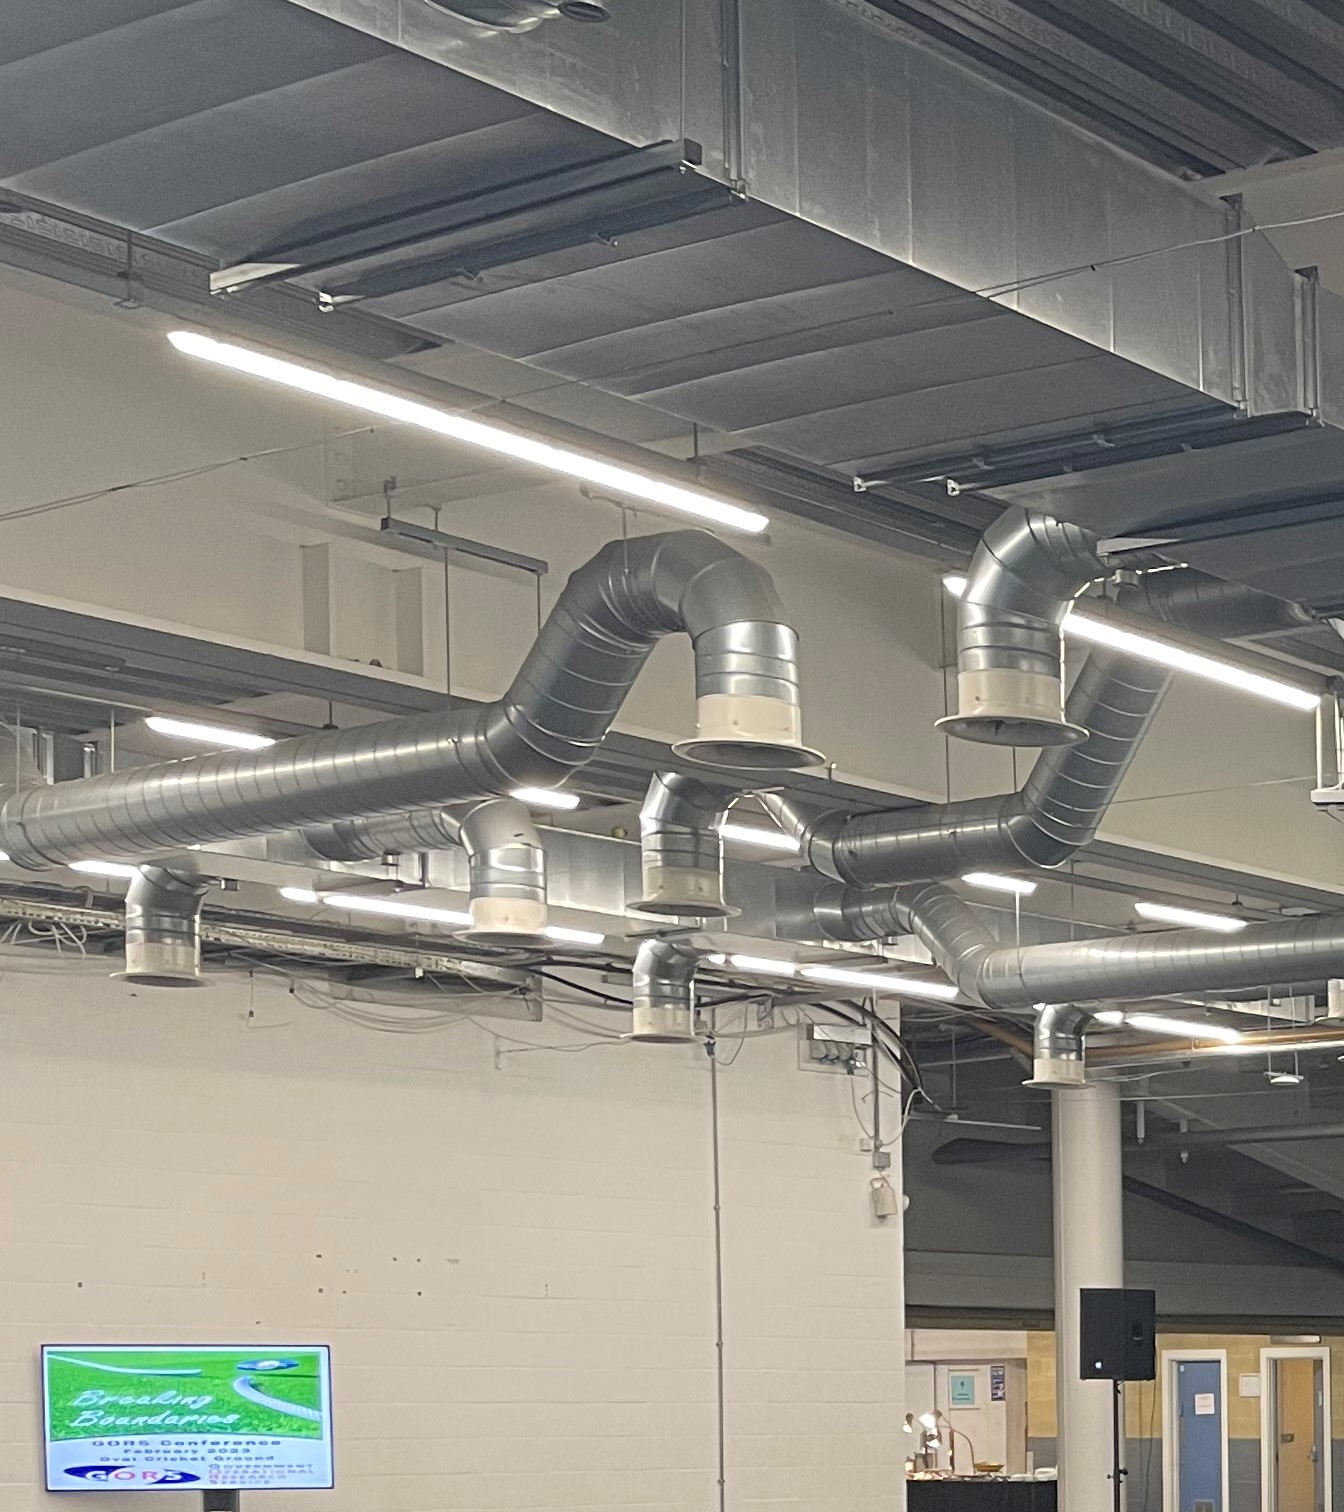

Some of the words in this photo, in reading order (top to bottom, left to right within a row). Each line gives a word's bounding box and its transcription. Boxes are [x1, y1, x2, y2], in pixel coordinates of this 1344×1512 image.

[70, 1389, 213, 1409] Breaking
[70, 1409, 240, 1428] Boundaries
[160, 1439, 282, 1447] Conference
[85, 1470, 182, 1482] GORS
